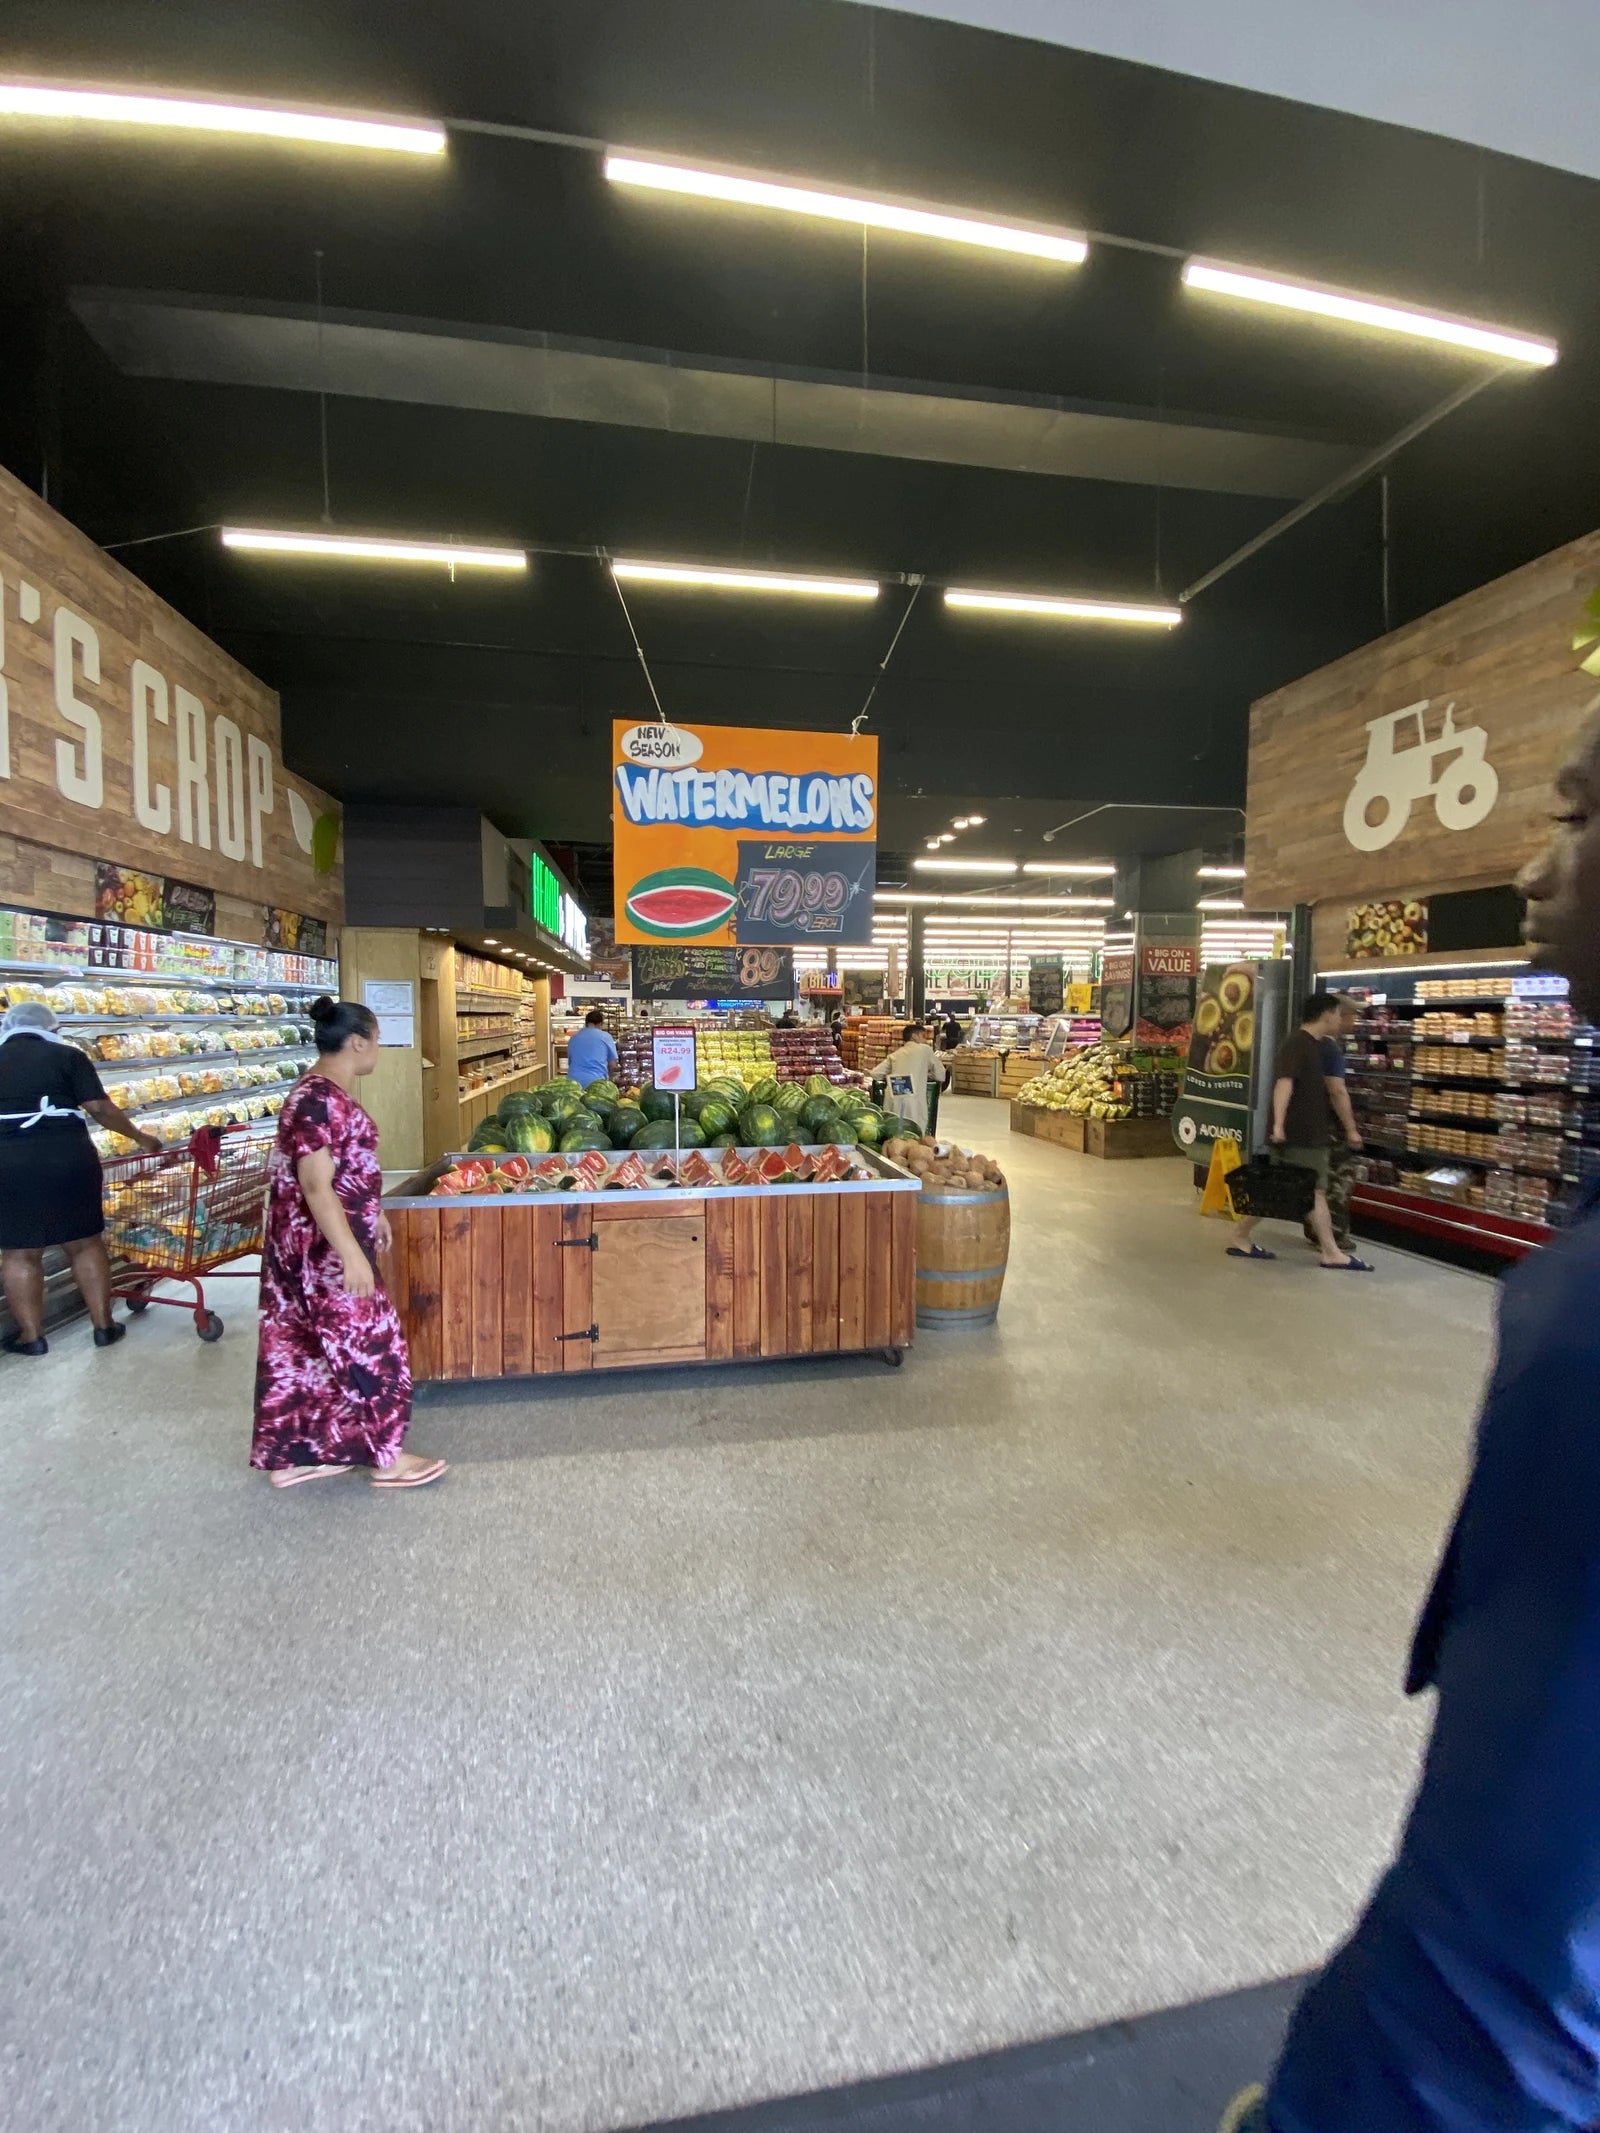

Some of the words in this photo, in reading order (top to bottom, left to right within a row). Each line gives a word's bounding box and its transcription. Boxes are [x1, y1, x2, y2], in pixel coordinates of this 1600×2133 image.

[0, 570, 103, 809] 'S
[132, 658, 274, 869] CROP
[637, 727, 666, 740] NEW
[629, 739, 681, 758] SEASON
[616, 765, 875, 829] WATERMELONS
[1154, 949, 1169, 957] BIG
[1171, 949, 1185, 958] ON
[1109, 962, 1118, 970] BIG
[1119, 960, 1128, 969] ON
[1148, 958, 1191, 973] VALUE
[1104, 968, 1131, 981] SAVINGS
[1187, 1075, 1206, 1088] LOVED
[1214, 1080, 1243, 1089] TRUSTED
